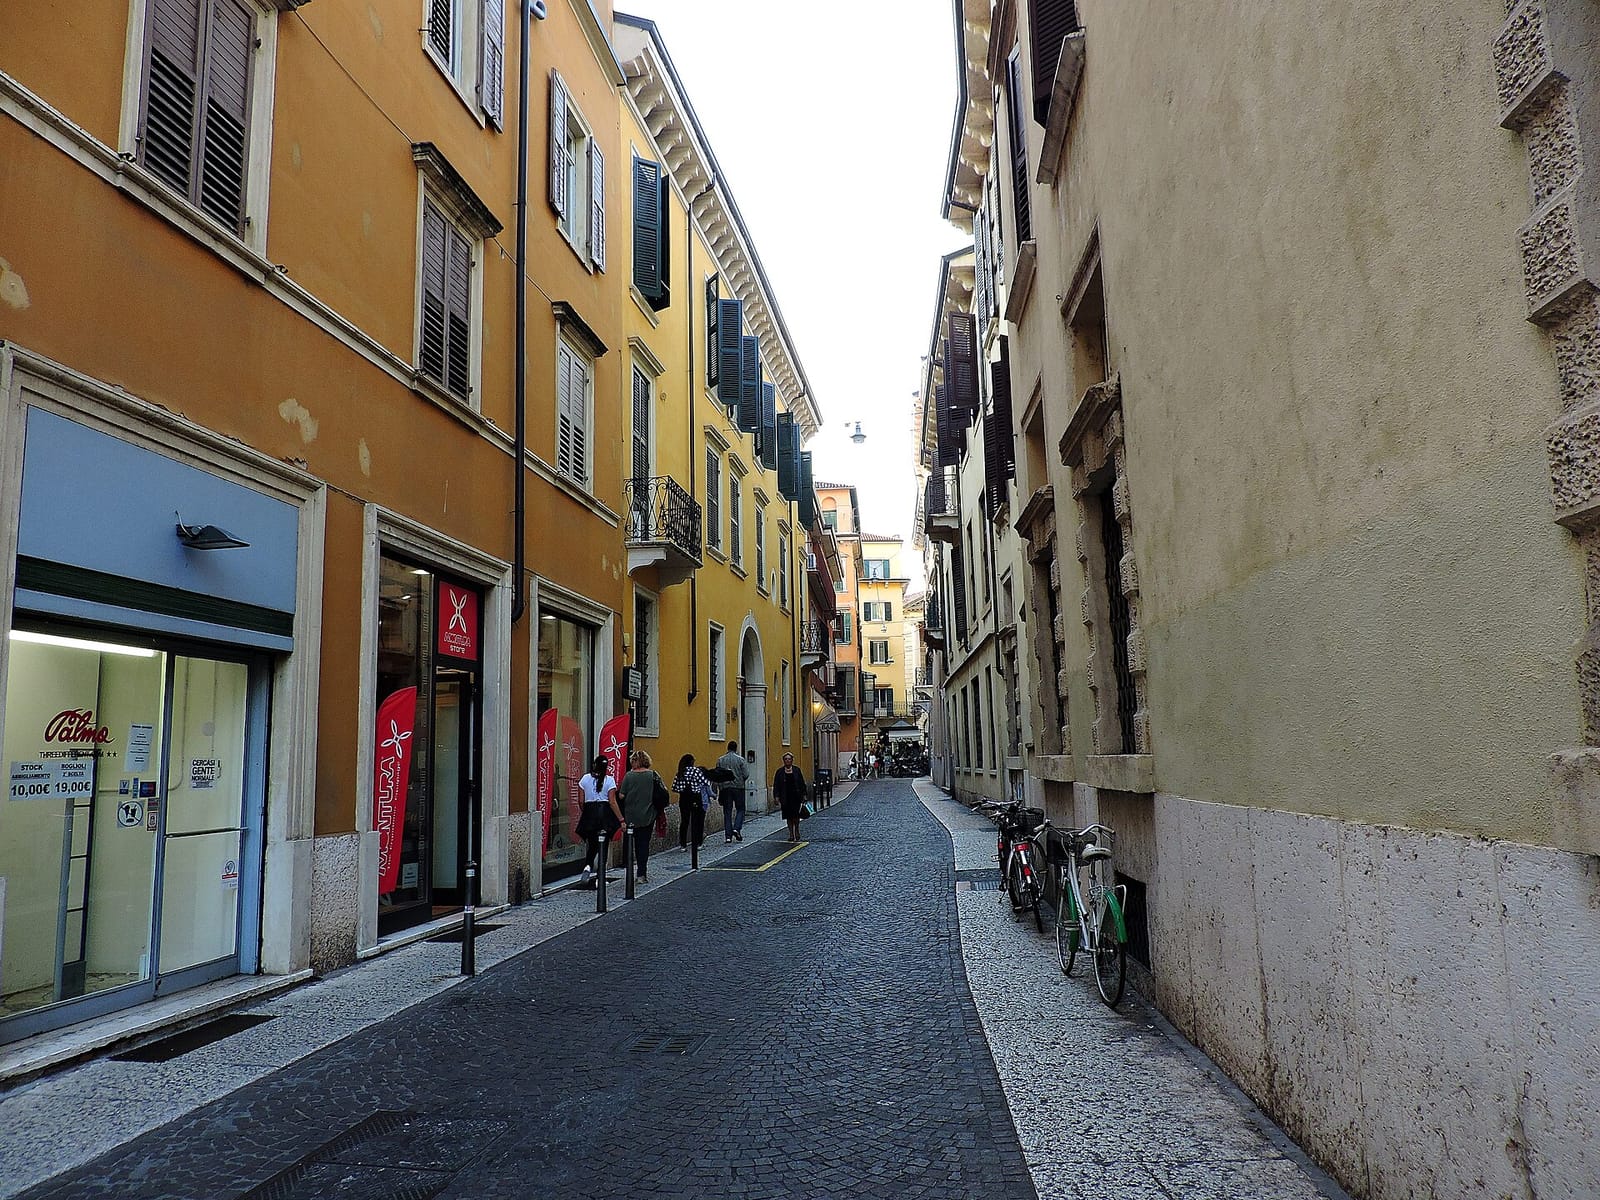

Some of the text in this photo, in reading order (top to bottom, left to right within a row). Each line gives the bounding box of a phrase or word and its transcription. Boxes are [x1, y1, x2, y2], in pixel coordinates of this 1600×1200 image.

[20, 763, 44, 771] STOCK
[192, 759, 216, 767] CERCASI
[191, 767, 216, 775] GENTE
[10, 783, 51, 798] 10,00€
[54, 781, 91, 794] 19,00€
